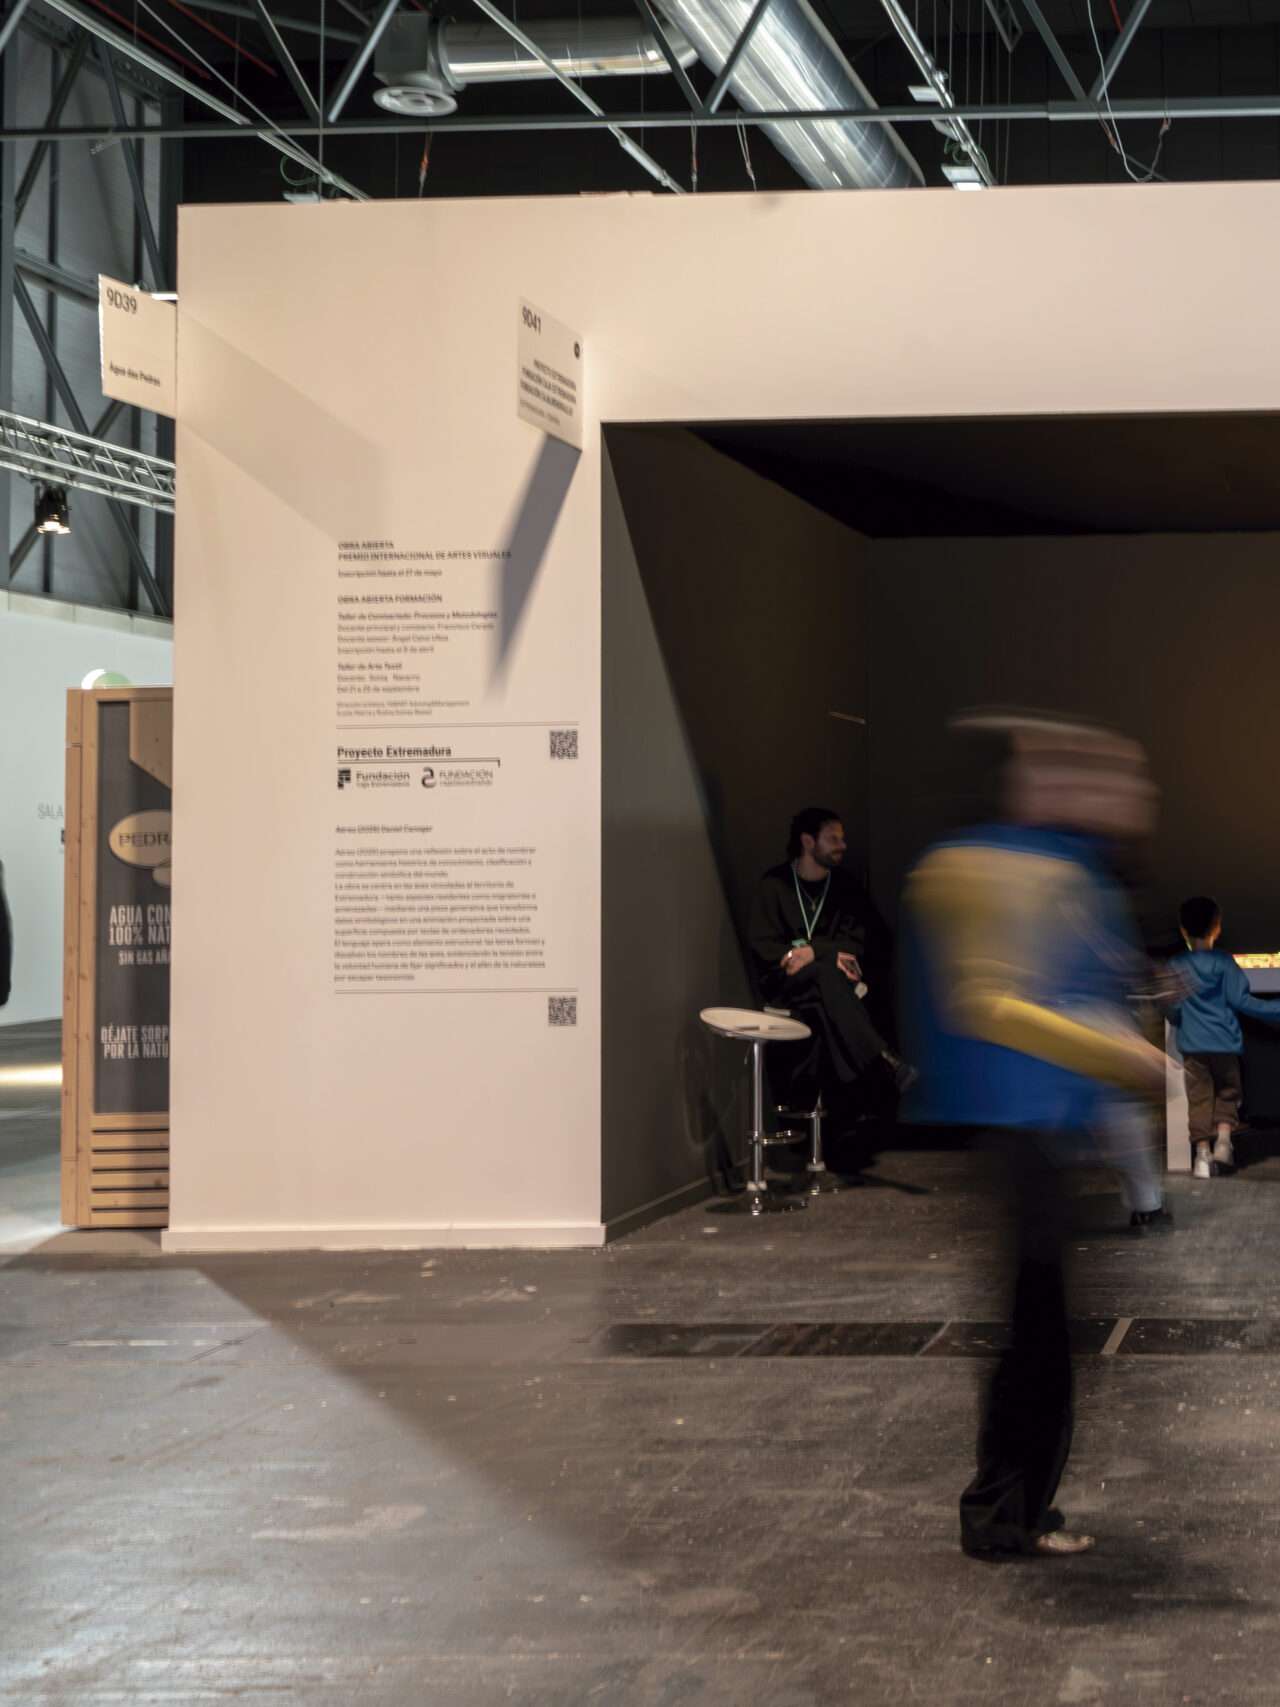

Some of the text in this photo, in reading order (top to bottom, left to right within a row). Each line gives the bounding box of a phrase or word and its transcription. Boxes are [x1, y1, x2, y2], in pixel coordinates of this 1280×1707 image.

[361, 541, 394, 549] ABIERTA
[338, 553, 368, 561] PREMIO
[370, 553, 434, 561] INTERNACIONAL
[447, 552, 473, 560] ARTES
[337, 746, 452, 760] Proyecto Extremadura
[356, 770, 410, 781] Fundación
[119, 831, 171, 847] PEDR
[109, 904, 143, 926] AGUA
[109, 927, 144, 946] 100%
[101, 1022, 138, 1043] DÉJATE
[103, 1043, 125, 1059] POR
[127, 1042, 140, 1059] LA
